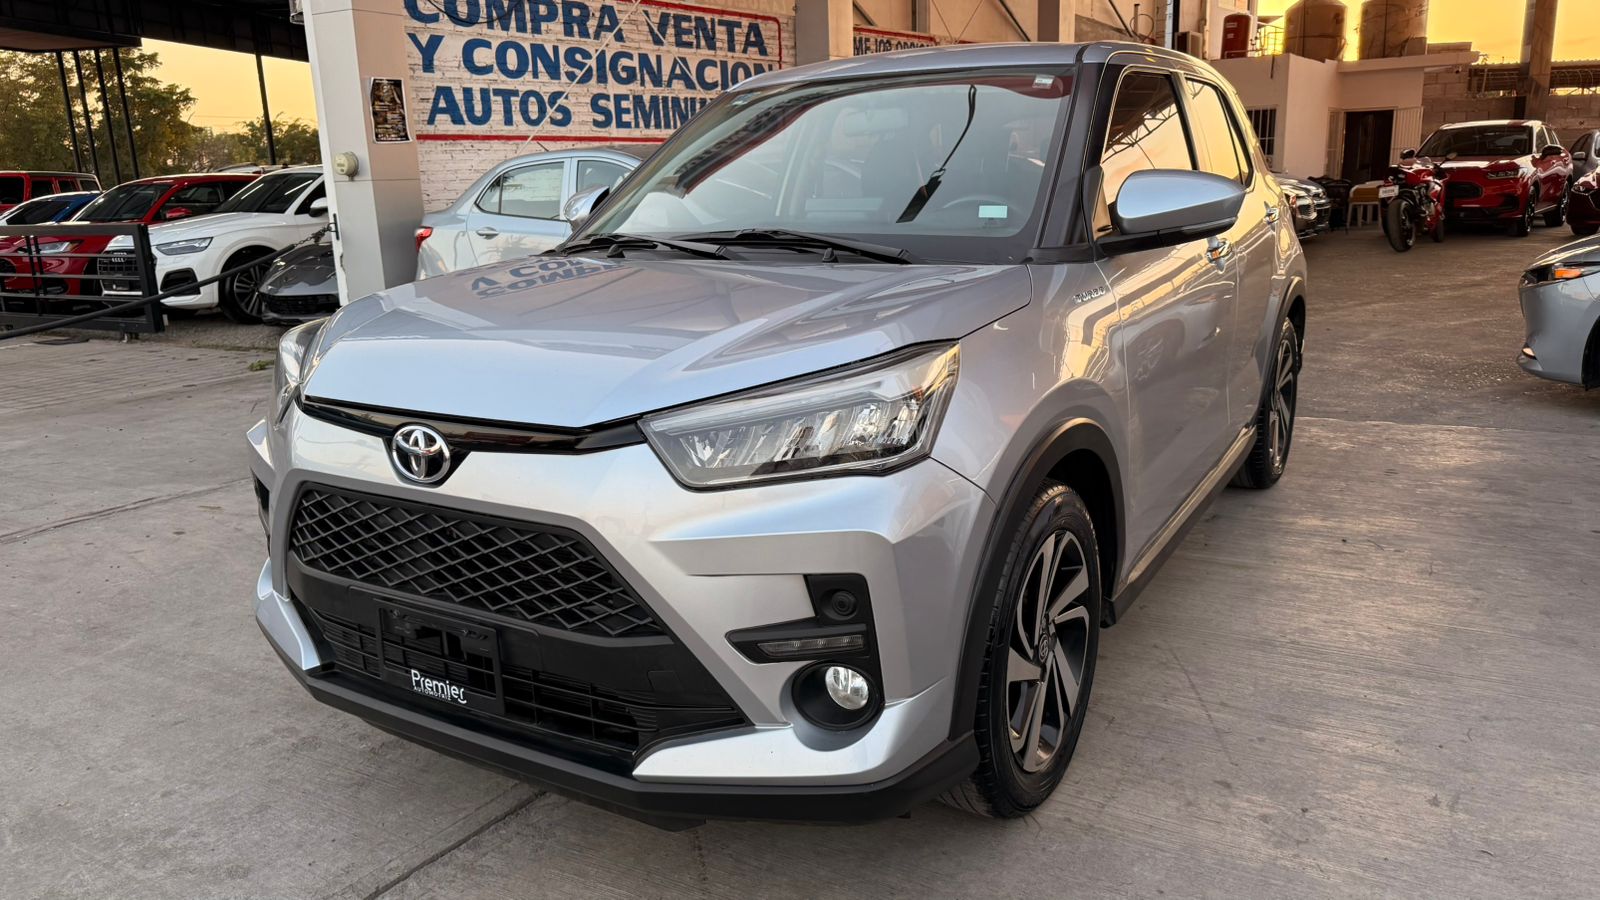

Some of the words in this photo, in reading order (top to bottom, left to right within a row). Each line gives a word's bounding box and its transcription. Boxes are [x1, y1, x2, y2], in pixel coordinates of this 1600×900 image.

[404, 0, 625, 43] COMPRA
[642, 10, 769, 56] VENTA
[407, 33, 445, 73] Y
[427, 86, 573, 128] AUTOS
[1073, 286, 1105, 303] TURBO
[411, 669, 467, 704] Premier
